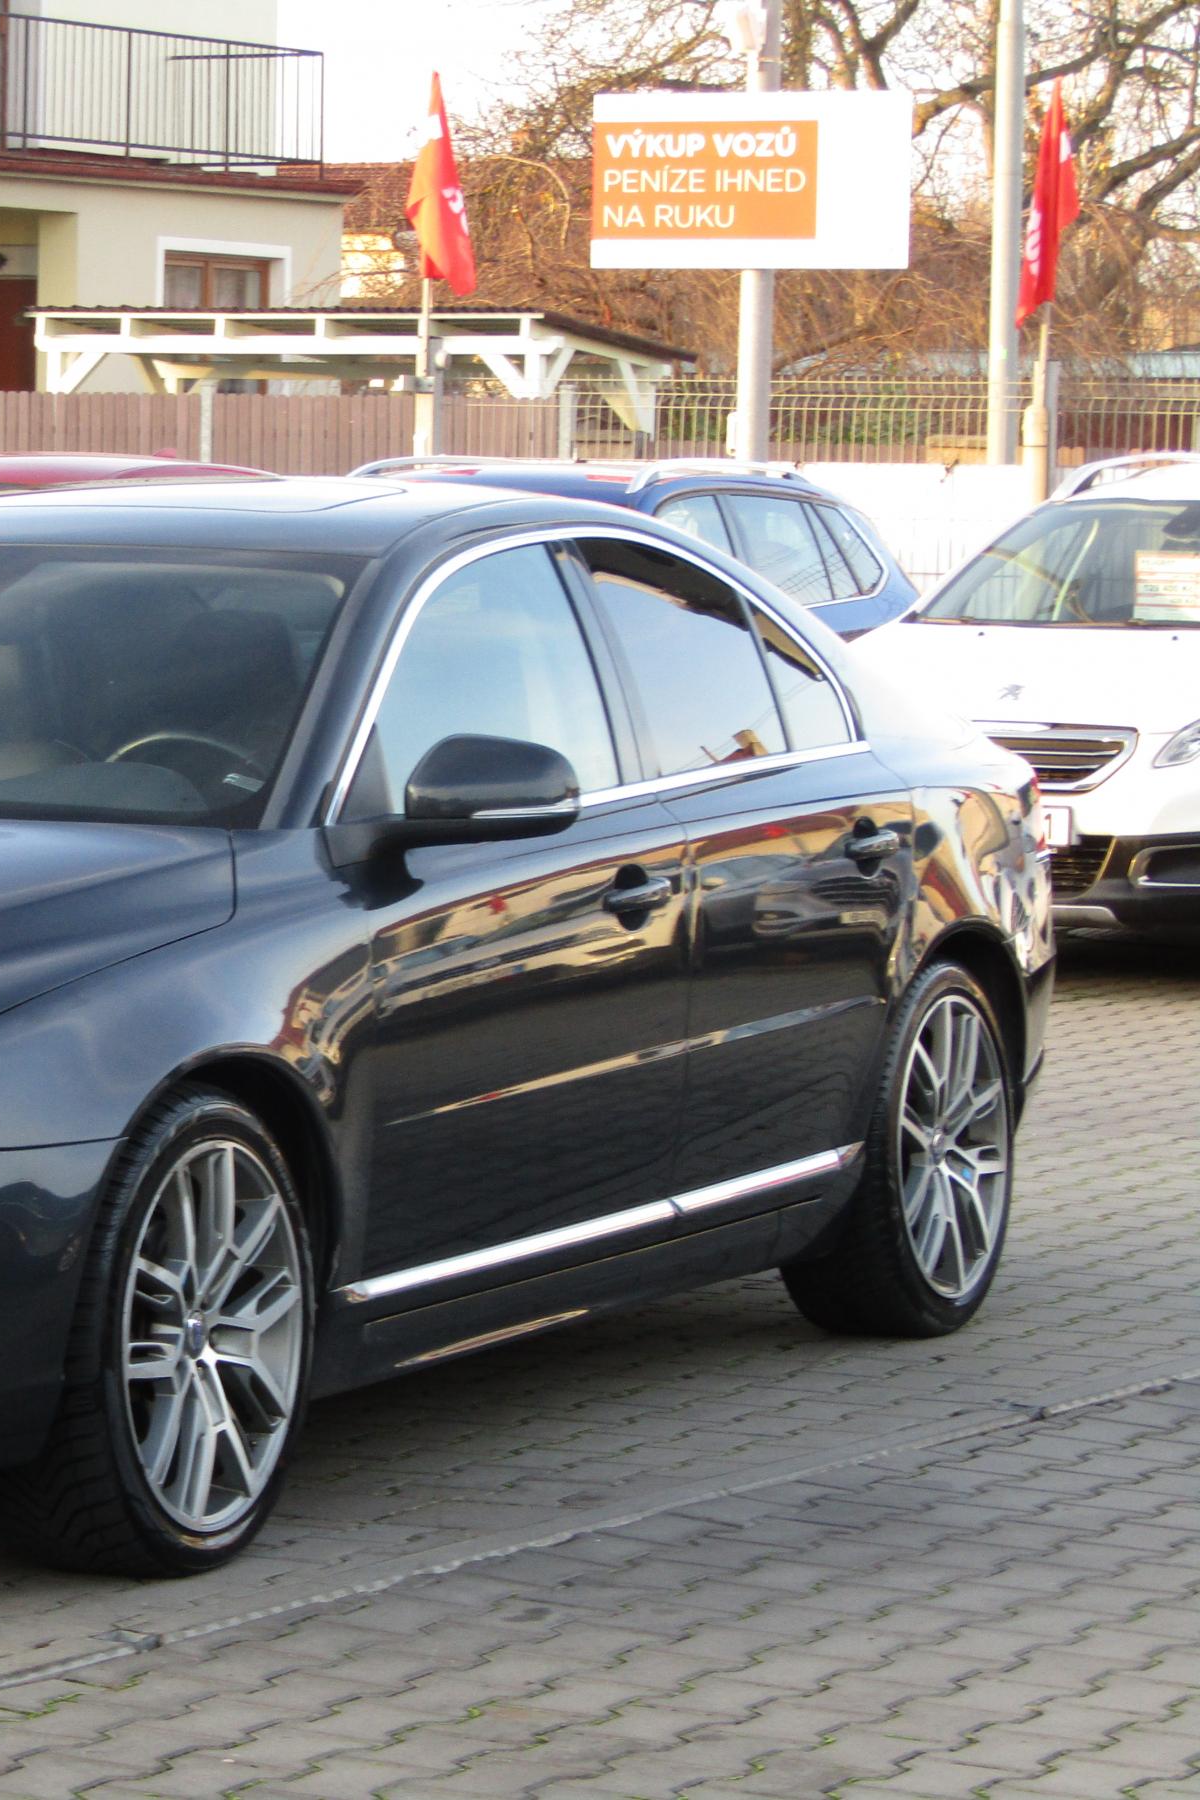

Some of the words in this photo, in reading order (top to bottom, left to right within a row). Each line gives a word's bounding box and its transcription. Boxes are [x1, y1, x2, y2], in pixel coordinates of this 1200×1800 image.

[606, 128, 706, 158] VÝKUP
[712, 126, 797, 157] VOZŮ
[603, 165, 706, 193] PENÍZE
[714, 169, 806, 192] IHNED
[602, 205, 645, 228] NA
[654, 205, 736, 228] RUKU
